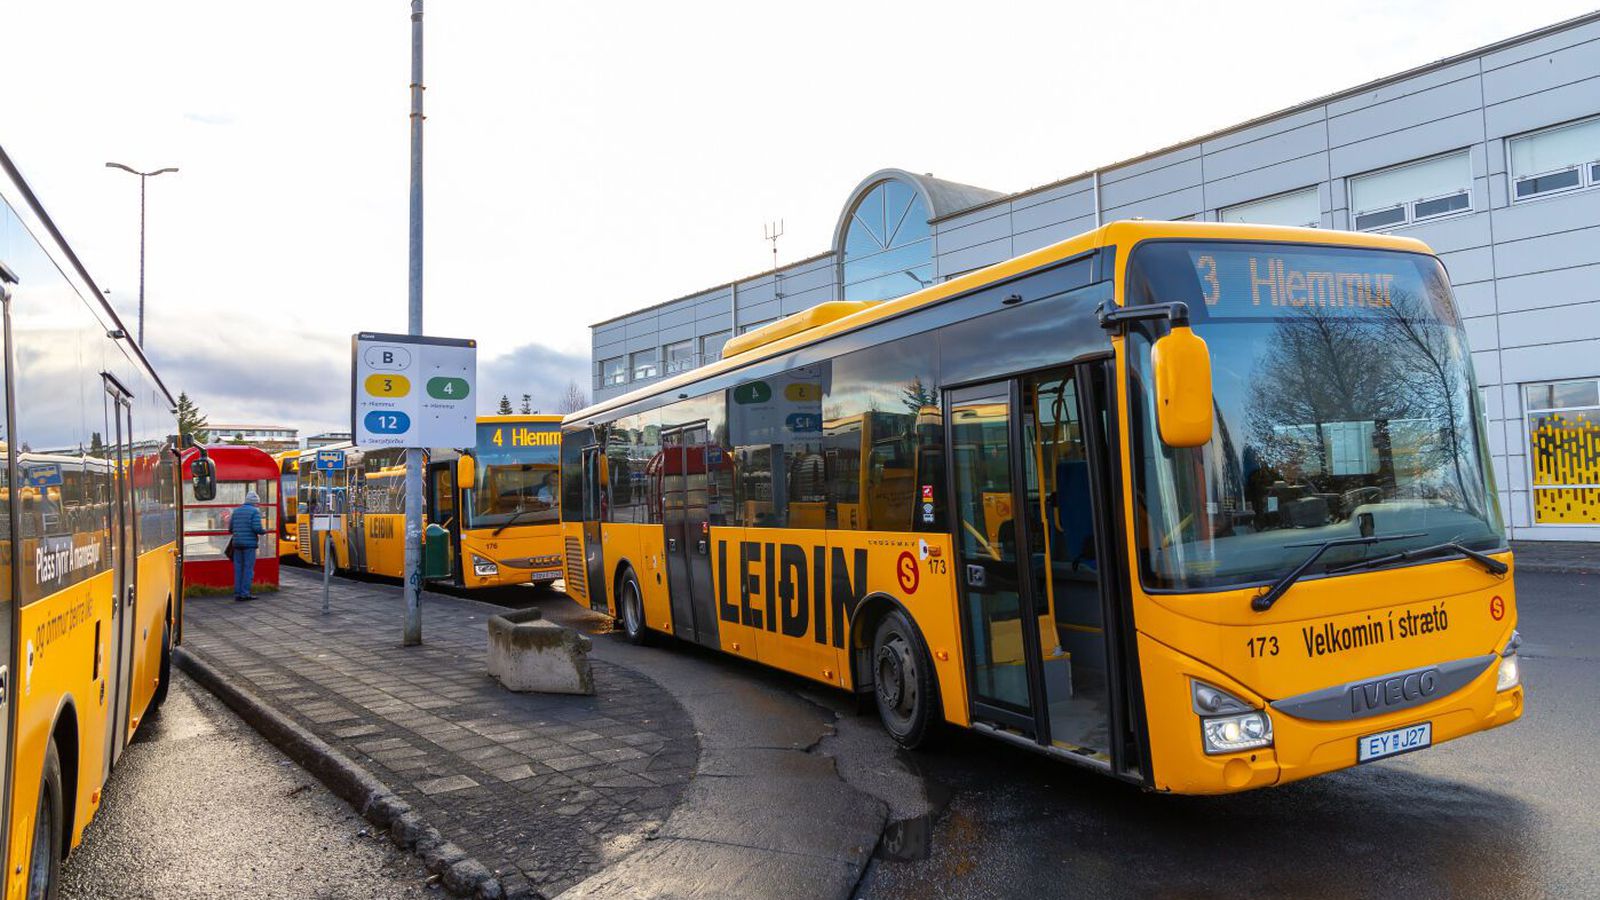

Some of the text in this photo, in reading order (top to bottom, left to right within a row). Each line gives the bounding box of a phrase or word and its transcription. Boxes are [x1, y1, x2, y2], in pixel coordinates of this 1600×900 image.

[1198, 255, 1394, 308] 3 Hlemmur
[383, 351, 393, 363] B
[383, 380, 392, 392] 3
[443, 382, 453, 394] 4
[378, 416, 397, 429] 12
[493, 428, 503, 446] 4
[36, 545, 55, 584] Pláss
[928, 559, 946, 575] 173
[718, 539, 868, 650] LEIÐIN
[1247, 602, 1448, 658] 173 Velkomin í strætó
[1350, 670, 1437, 713] IVECO
[1370, 735, 1389, 755] EY
[1402, 727, 1425, 747] J27
